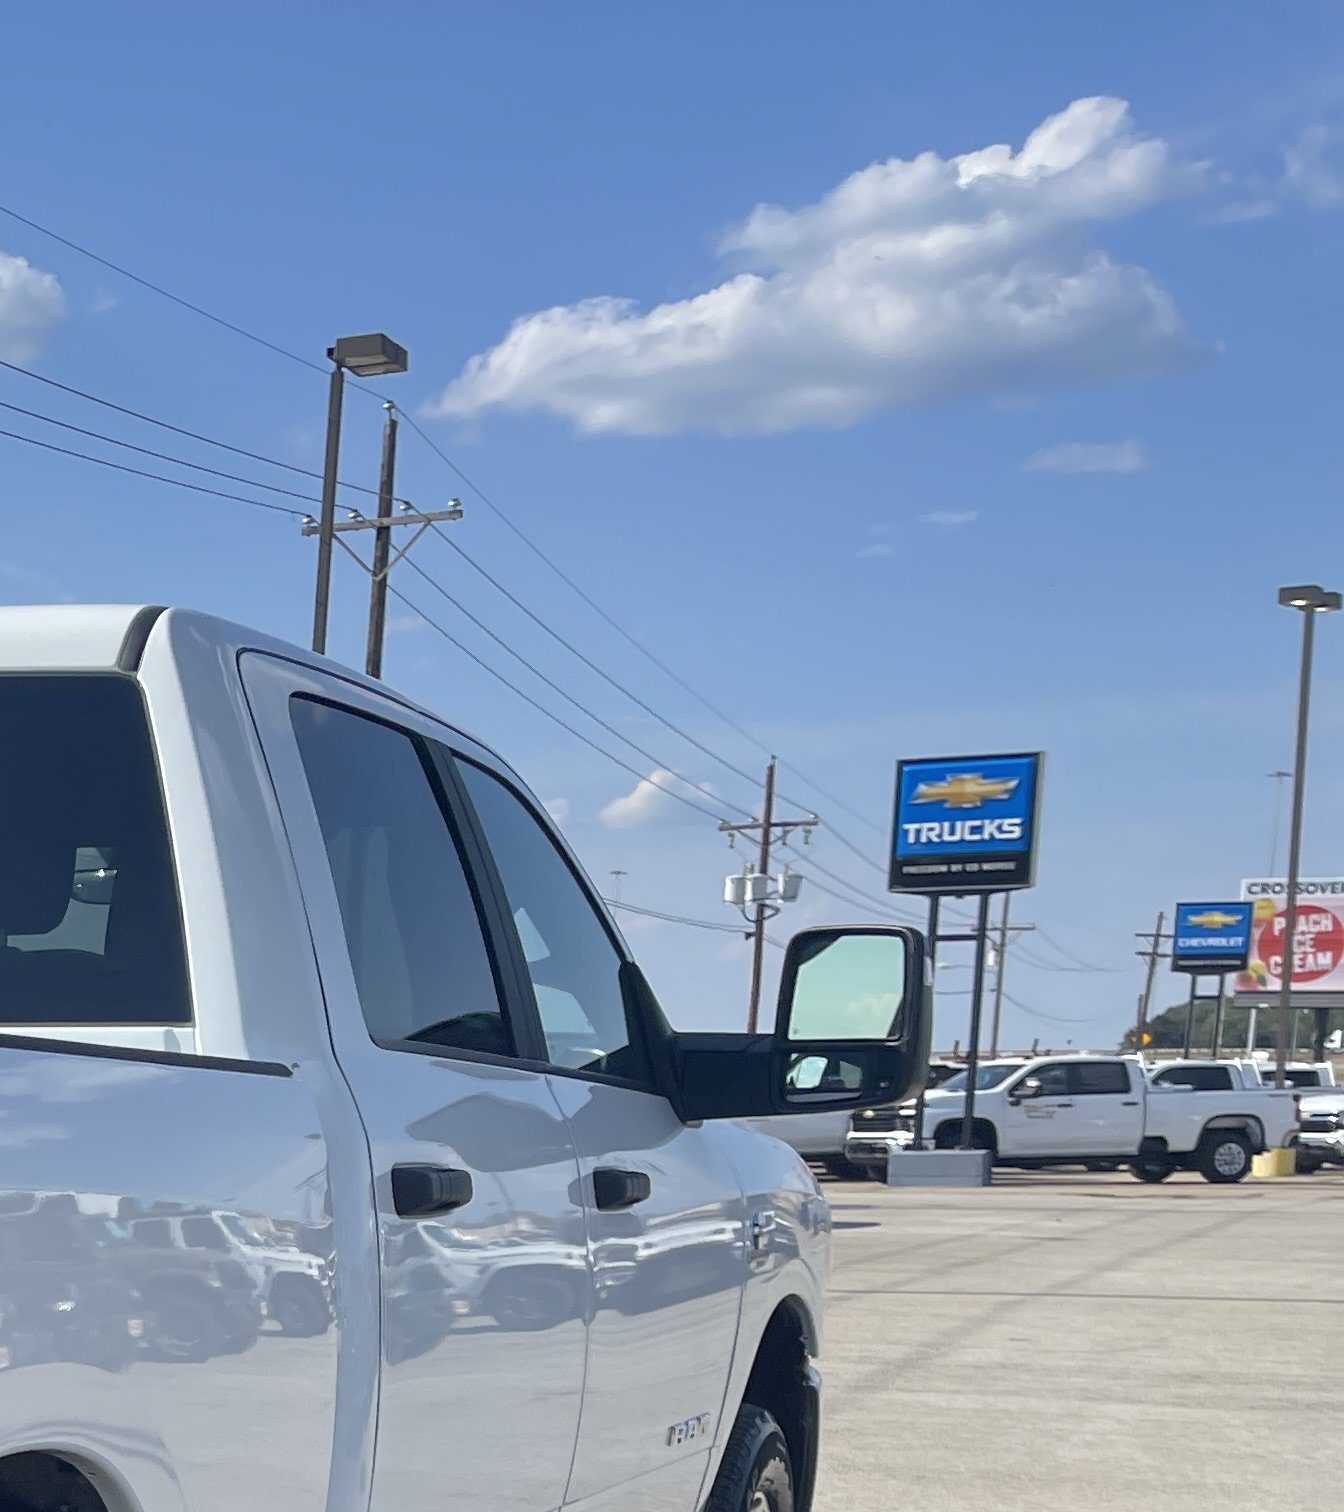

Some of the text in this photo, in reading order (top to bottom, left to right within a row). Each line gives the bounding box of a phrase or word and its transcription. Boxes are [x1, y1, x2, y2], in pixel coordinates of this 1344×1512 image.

[902, 818, 1024, 843] TRUCKS
[1247, 882, 1344, 895] CROSOVE
[1273, 913, 1332, 936] PACH
[1290, 934, 1316, 953] CE
[1269, 951, 1332, 975] CEAM
